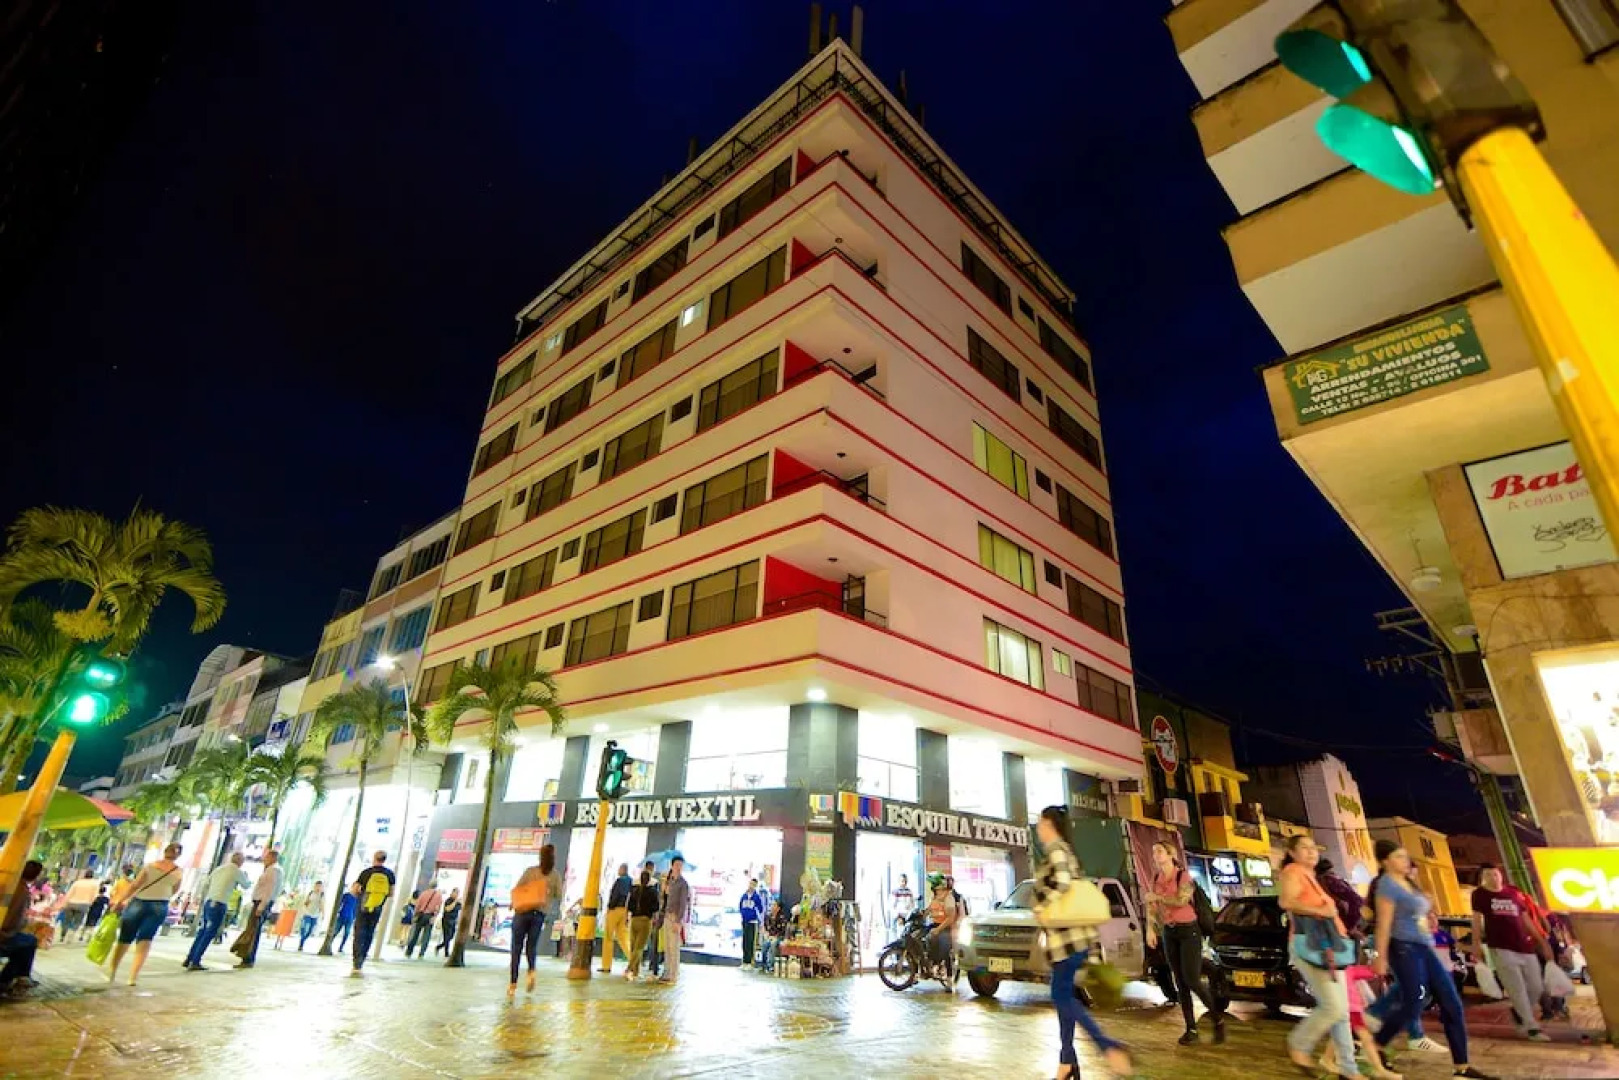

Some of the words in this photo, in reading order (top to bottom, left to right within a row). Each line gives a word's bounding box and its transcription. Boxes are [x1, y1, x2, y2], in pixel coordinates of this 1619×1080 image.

[1301, 399, 1333, 414] CALLE
[1410, 362, 1457, 381] OFICINA
[1310, 380, 1368, 402] VENTAS
[1385, 350, 1461, 380] AVALUOS
[1311, 341, 1456, 394] ARRENDAMIENTOS
[1509, 502, 1519, 511] A
[1525, 494, 1563, 508] cada
[665, 795, 761, 822] TEXTIL
[886, 804, 972, 837] ESQUINA
